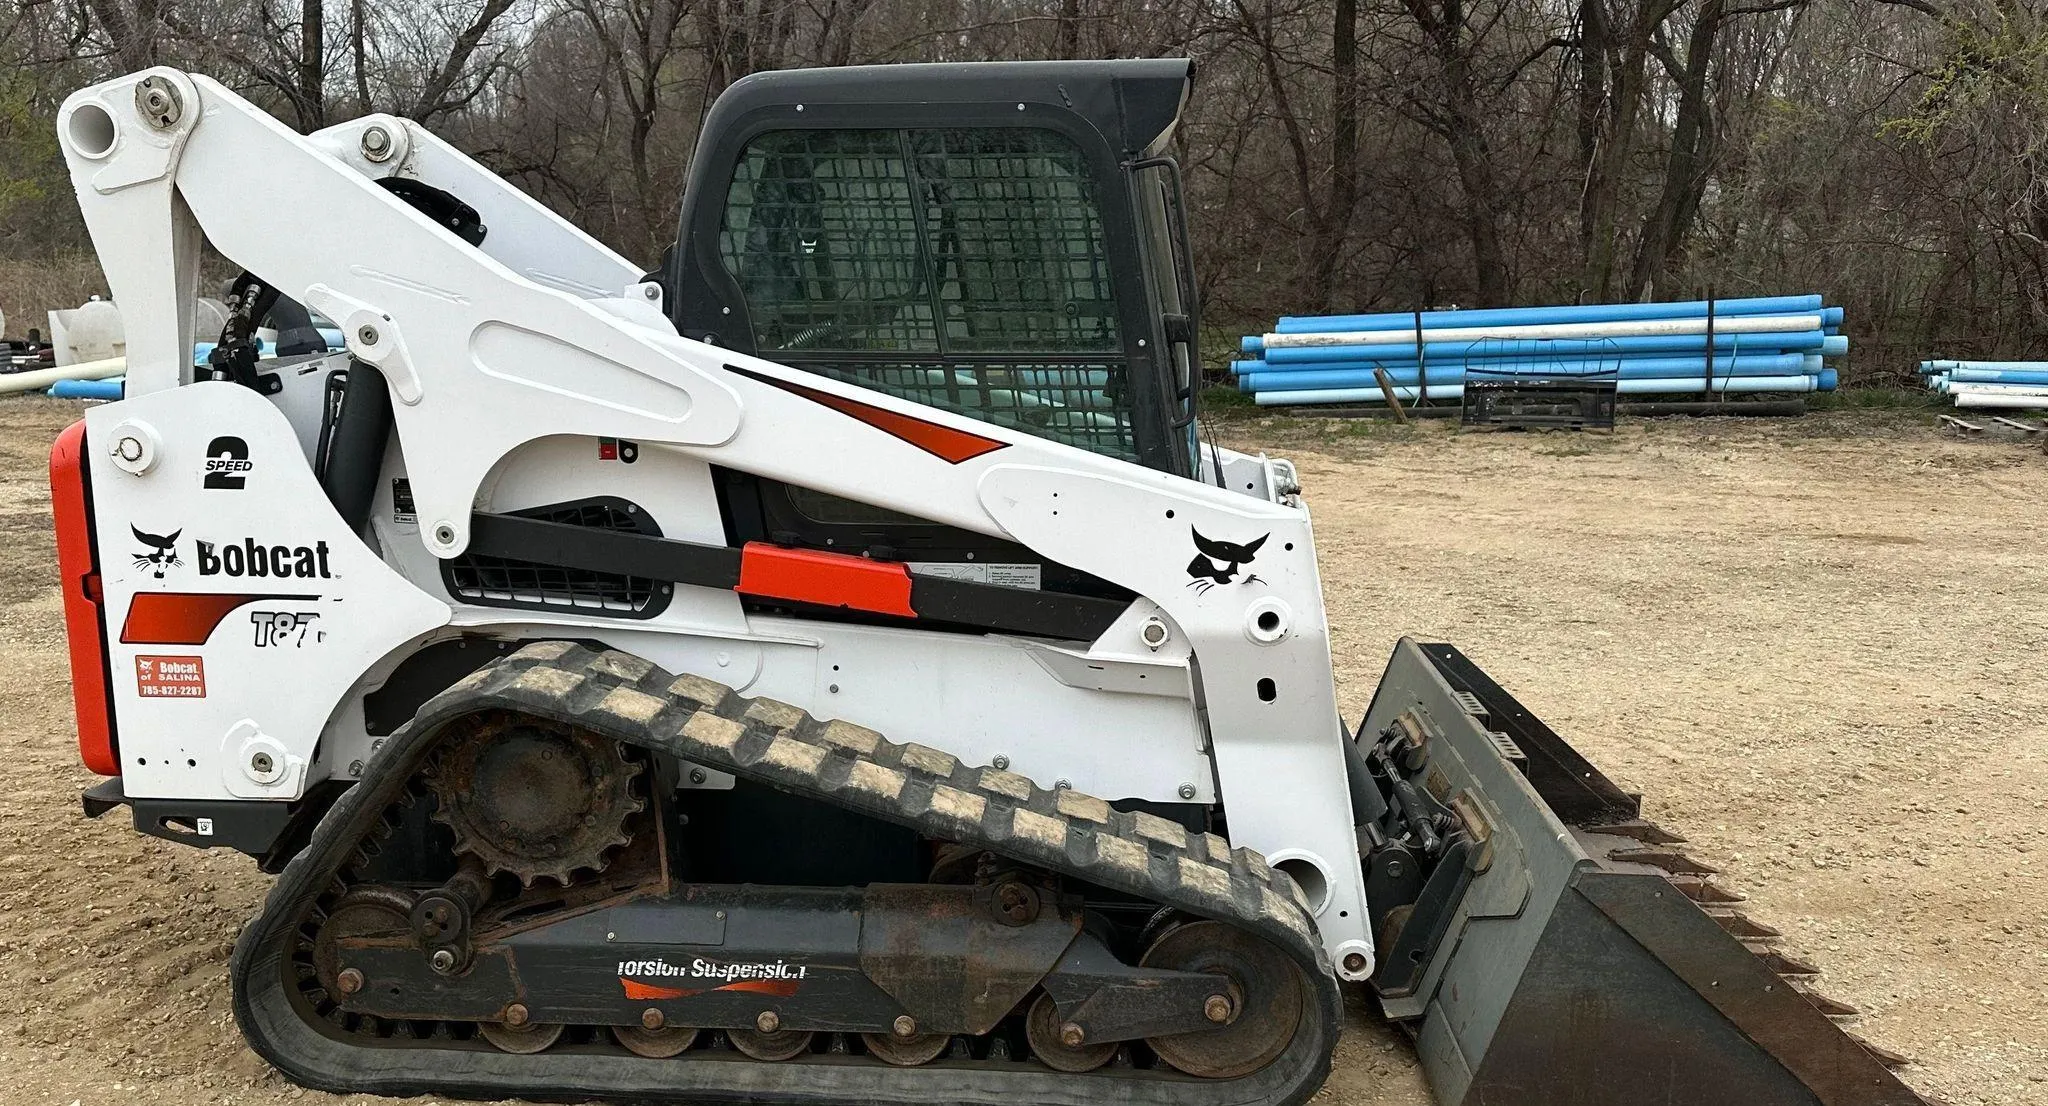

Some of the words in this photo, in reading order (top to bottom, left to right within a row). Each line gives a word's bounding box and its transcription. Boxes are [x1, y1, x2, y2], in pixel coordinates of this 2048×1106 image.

[203, 436, 249, 490] 2
[205, 460, 253, 471] SPEED
[196, 537, 331, 579] Bobcat
[160, 661, 198, 674] Bobcat
[158, 674, 200, 682] SALINA
[142, 685, 202, 696] 785-827-2287
